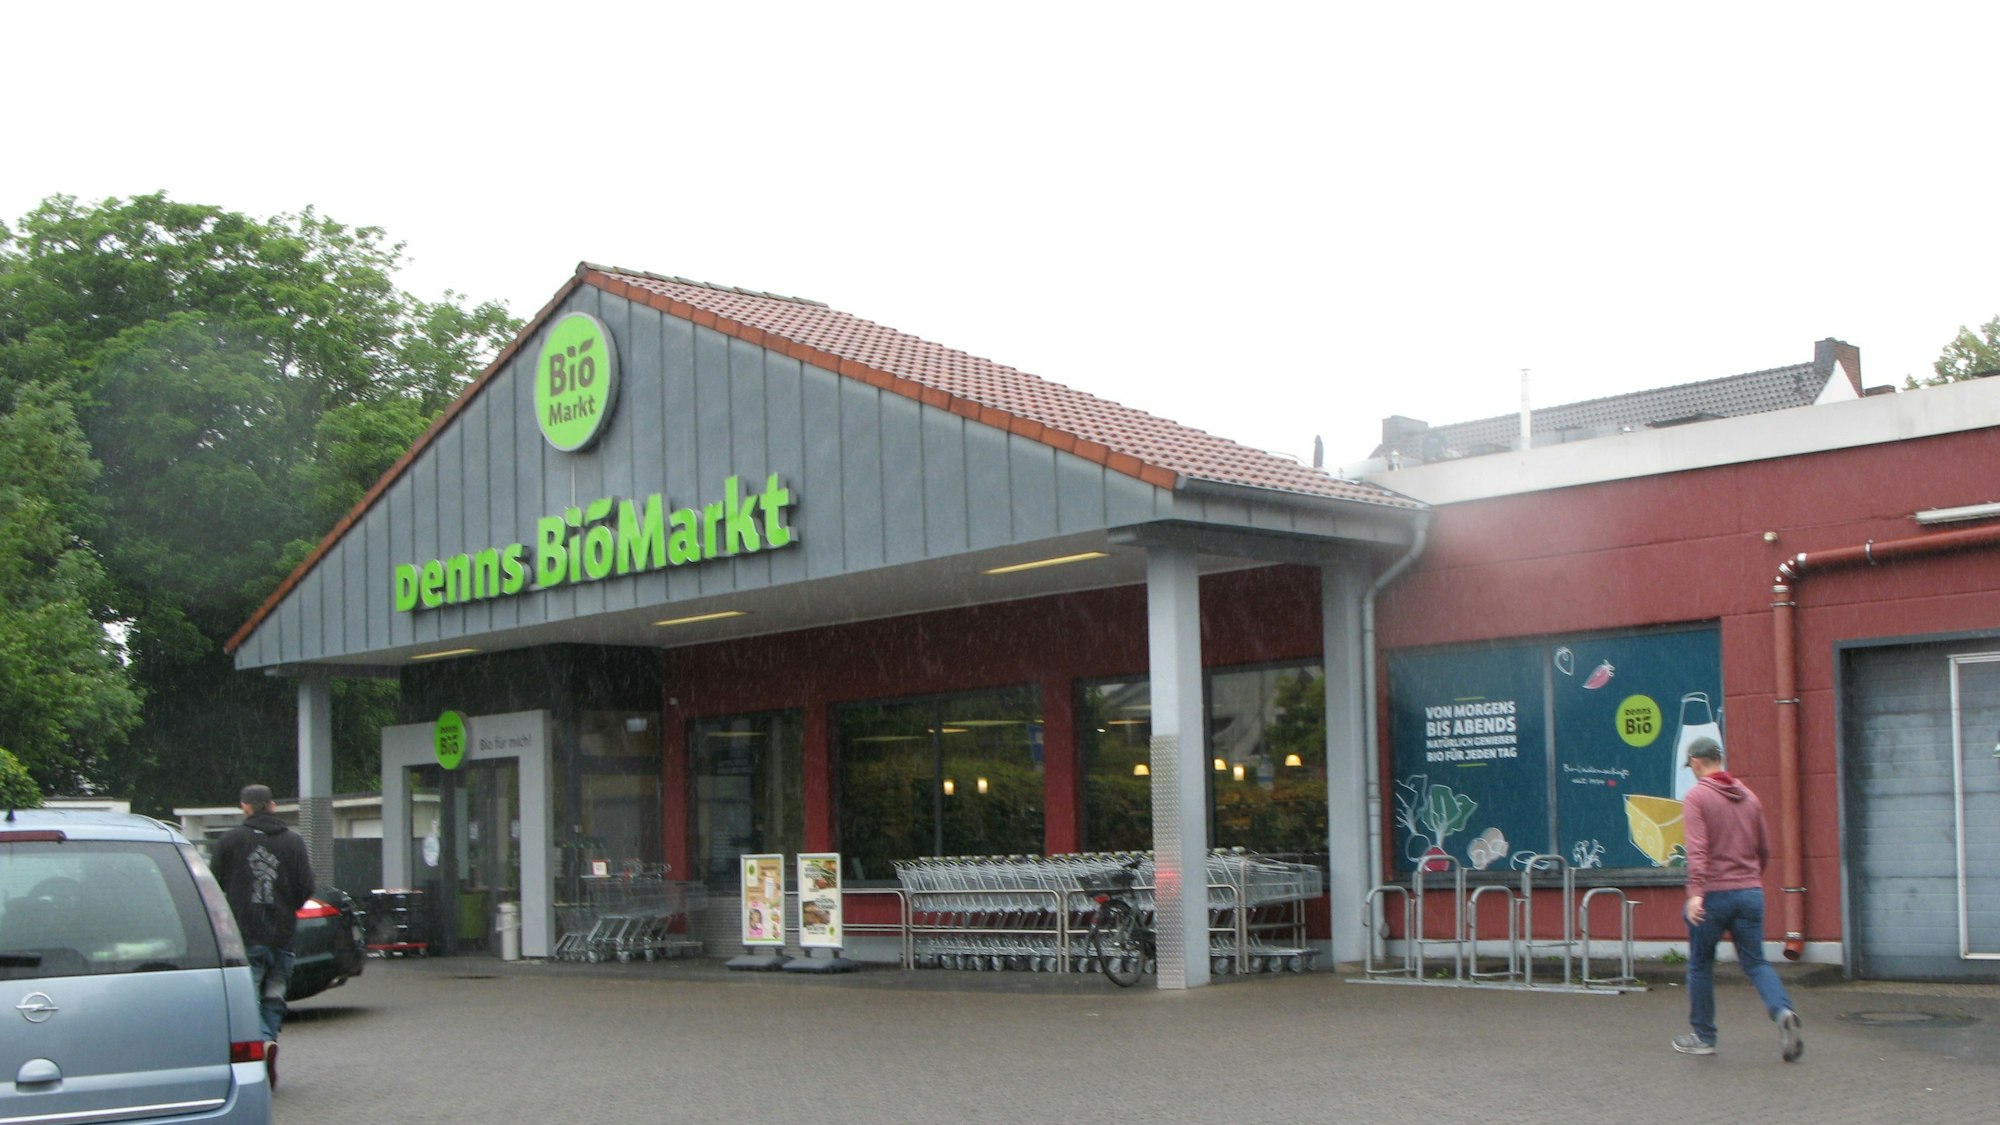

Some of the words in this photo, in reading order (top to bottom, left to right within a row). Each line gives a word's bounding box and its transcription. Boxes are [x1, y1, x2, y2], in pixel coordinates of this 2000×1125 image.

[550, 338, 595, 397] Bio
[549, 388, 595, 426] Markt
[537, 472, 797, 588] BioMarkt
[1425, 705, 1452, 719] VON
[1453, 700, 1516, 718] MORGENS
[1426, 720, 1451, 737] BIS
[1453, 715, 1517, 735] ABENDS
[1625, 716, 1652, 734] Bio
[1425, 736, 1474, 749] NATÜRLICH
[1426, 751, 1444, 762] BIO
[1445, 748, 1465, 761] FÜR
[1465, 748, 1497, 760] JEDEN
[1497, 746, 1518, 758] TAG
